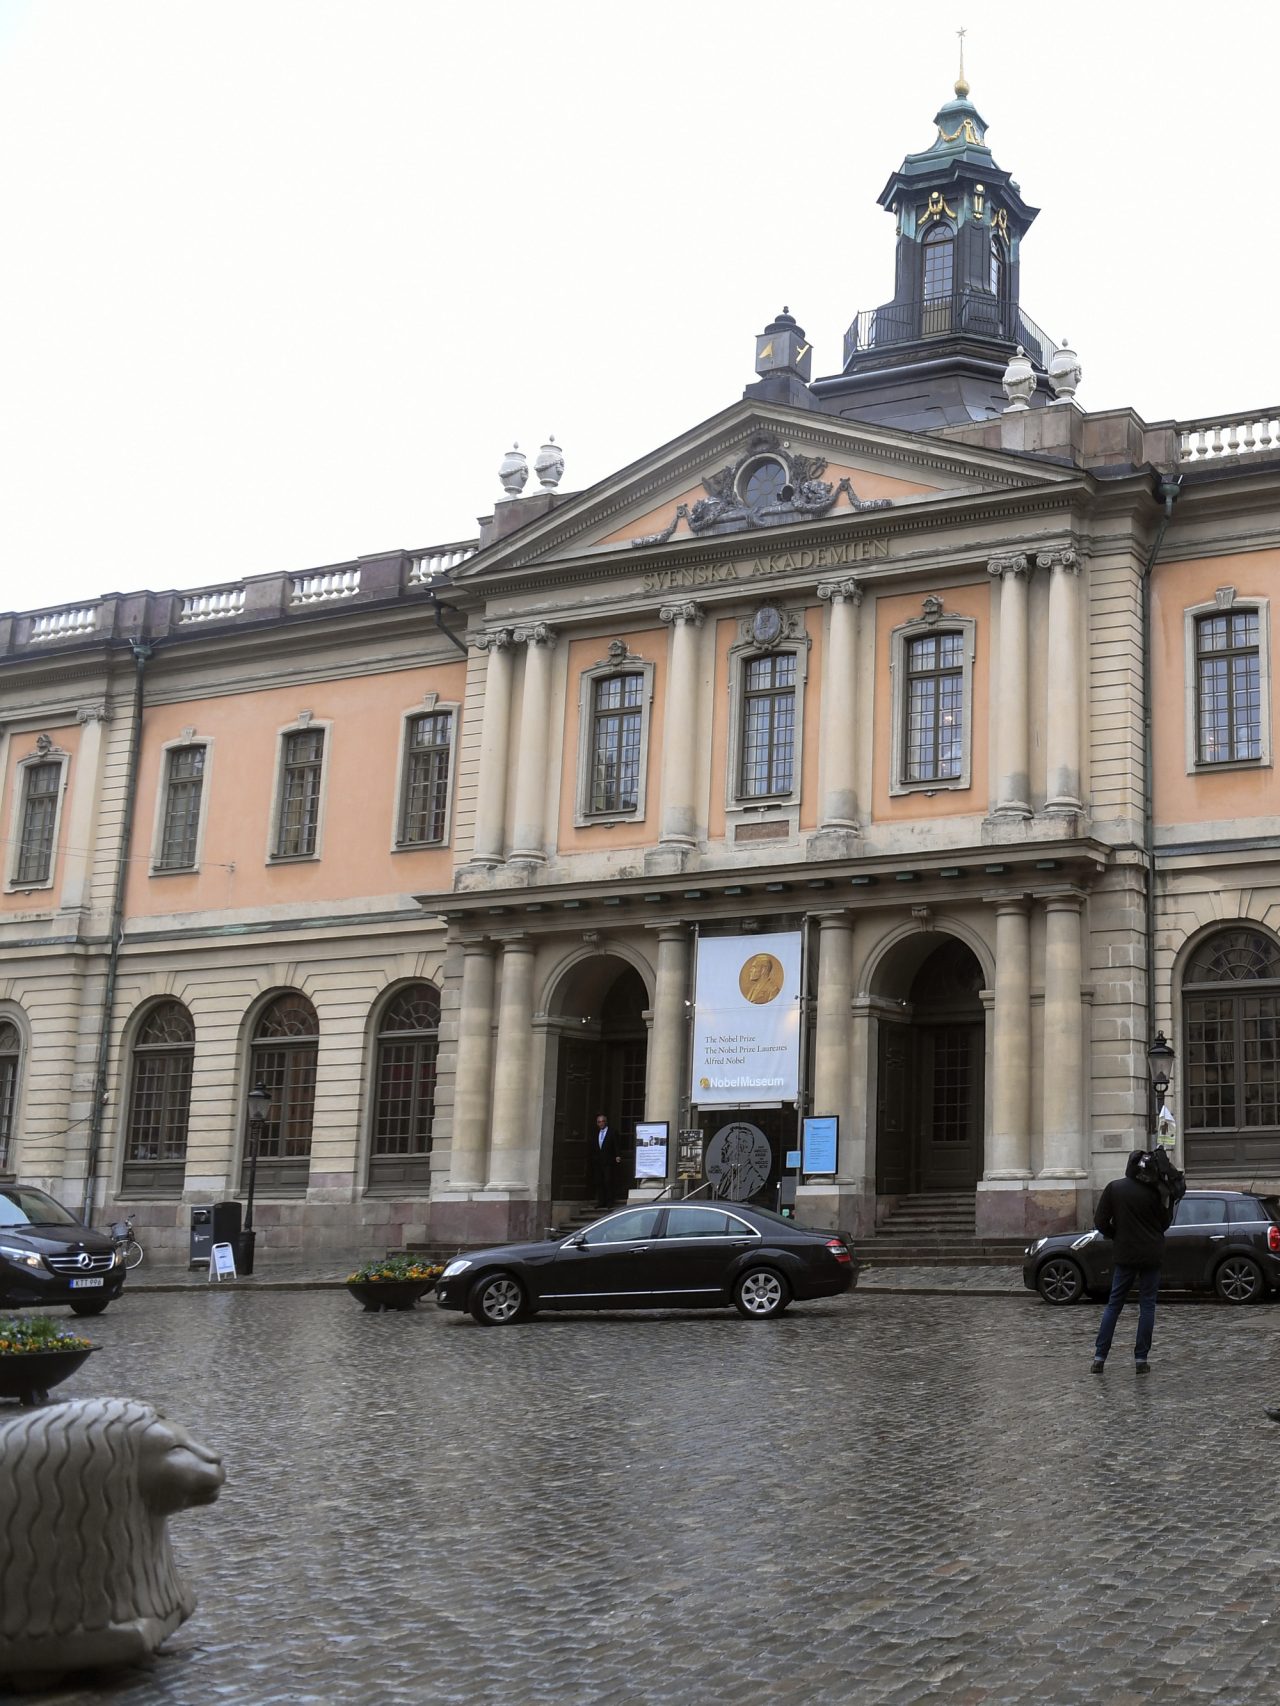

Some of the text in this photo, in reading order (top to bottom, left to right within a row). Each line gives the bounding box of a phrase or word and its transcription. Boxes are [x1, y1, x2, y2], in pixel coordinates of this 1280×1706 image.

[641, 539, 890, 592] SVENSKA AKADEMIEN
[718, 1035, 738, 1043] Nobel
[739, 1035, 756, 1043] Prize
[704, 1044, 788, 1054] The Nobel Prize Laureates
[704, 1056, 745, 1065] Alfred Nobel
